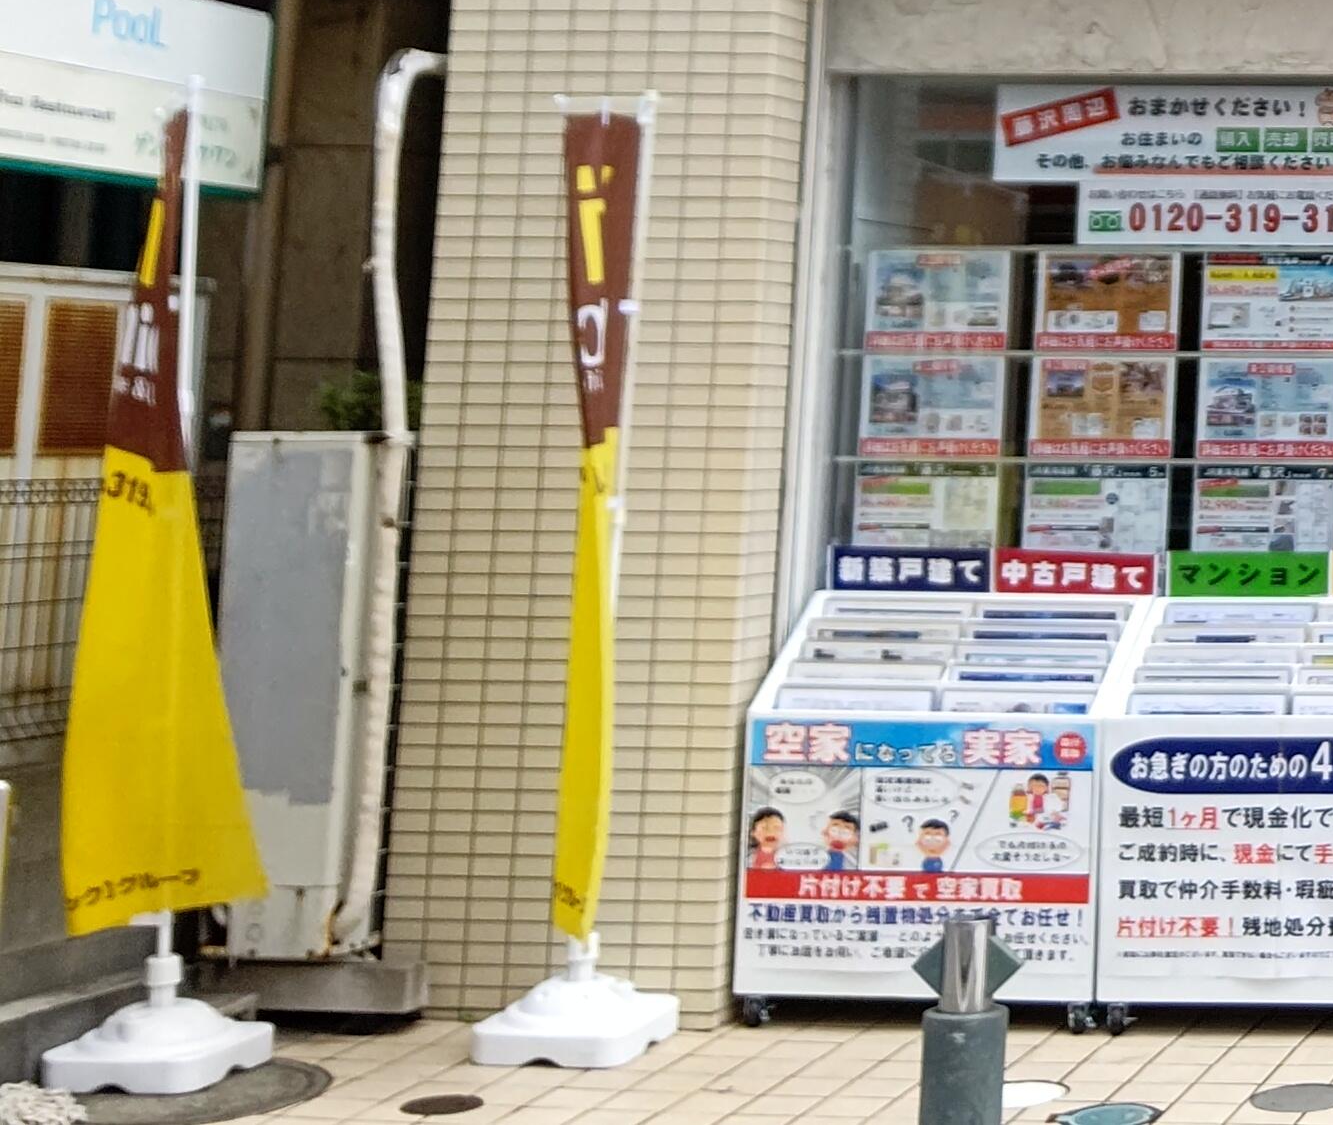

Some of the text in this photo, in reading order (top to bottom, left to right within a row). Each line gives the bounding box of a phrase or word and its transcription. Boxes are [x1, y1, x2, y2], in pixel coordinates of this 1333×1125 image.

[1120, 131, 1203, 147] お住まいの
[1265, 131, 1300, 148] 売却
[837, 555, 984, 584] 新築戸建て
[1001, 558, 1147, 589] 中古戸建て
[1177, 562, 1321, 587] マンション
